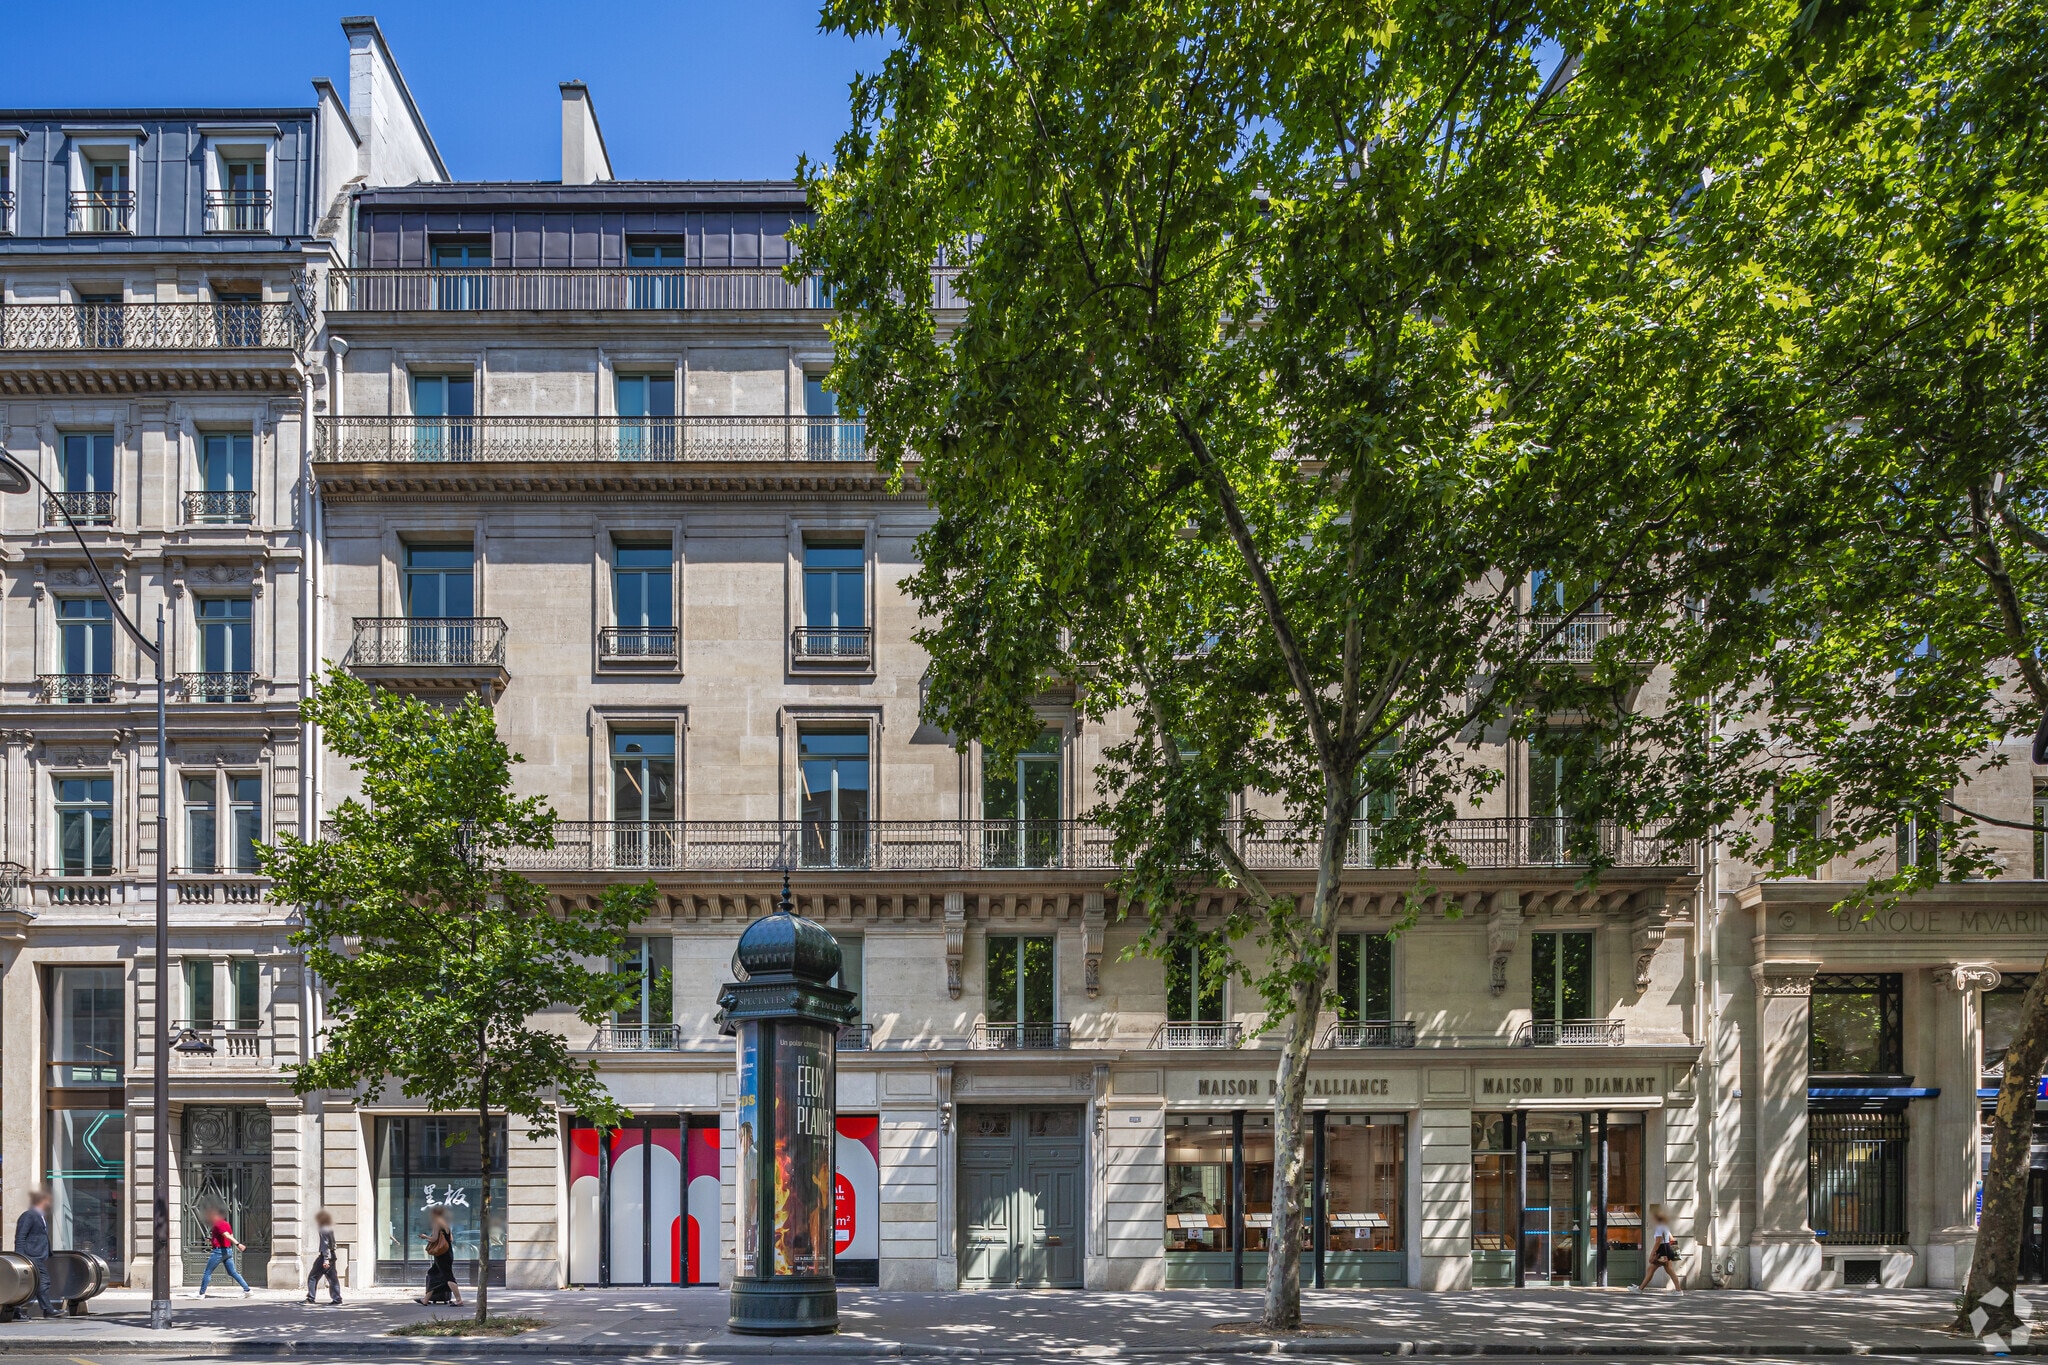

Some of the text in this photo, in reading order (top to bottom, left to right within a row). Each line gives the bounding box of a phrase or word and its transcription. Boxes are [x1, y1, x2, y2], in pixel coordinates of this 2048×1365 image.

[1836, 910, 1941, 933] BANQUE
[739, 996, 786, 1005] SPECTACLES
[797, 1055, 809, 1064] DES
[797, 1065, 825, 1098] FEUX
[1198, 1079, 1258, 1095] MAISON
[1483, 1077, 1656, 1094] MAISON DU DIAMANT
[797, 1106, 829, 1137] PLAINE
